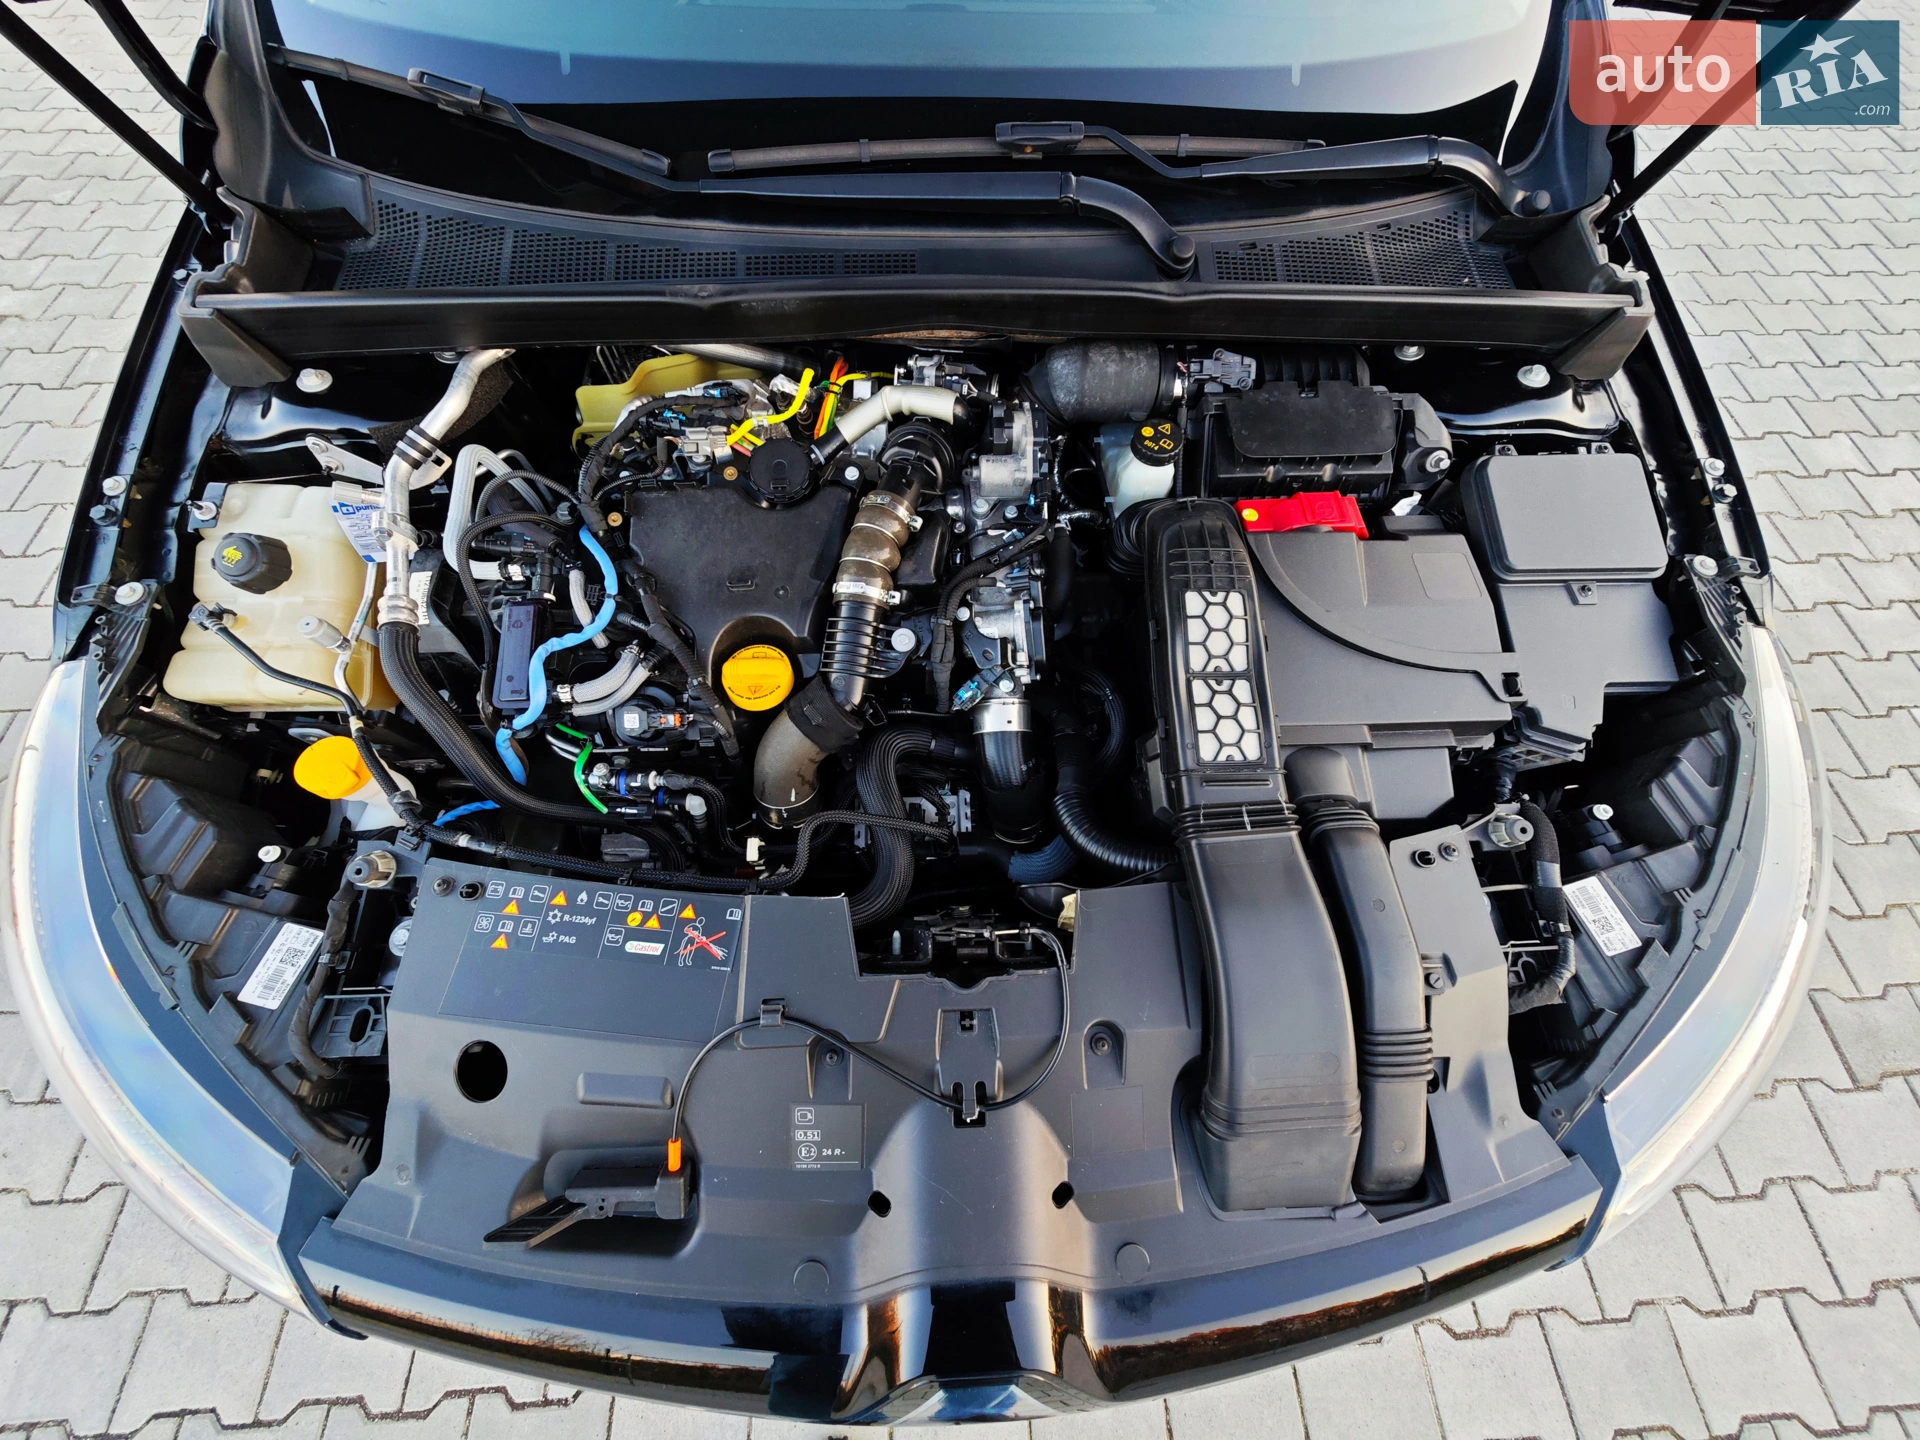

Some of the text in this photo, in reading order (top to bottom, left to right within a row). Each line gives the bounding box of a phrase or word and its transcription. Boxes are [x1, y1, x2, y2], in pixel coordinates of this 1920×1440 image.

[562, 914, 597, 926] R-1234yf
[558, 935, 577, 944] PAG
[634, 943, 660, 953] Castrol
[822, 1148, 832, 1156] 24
